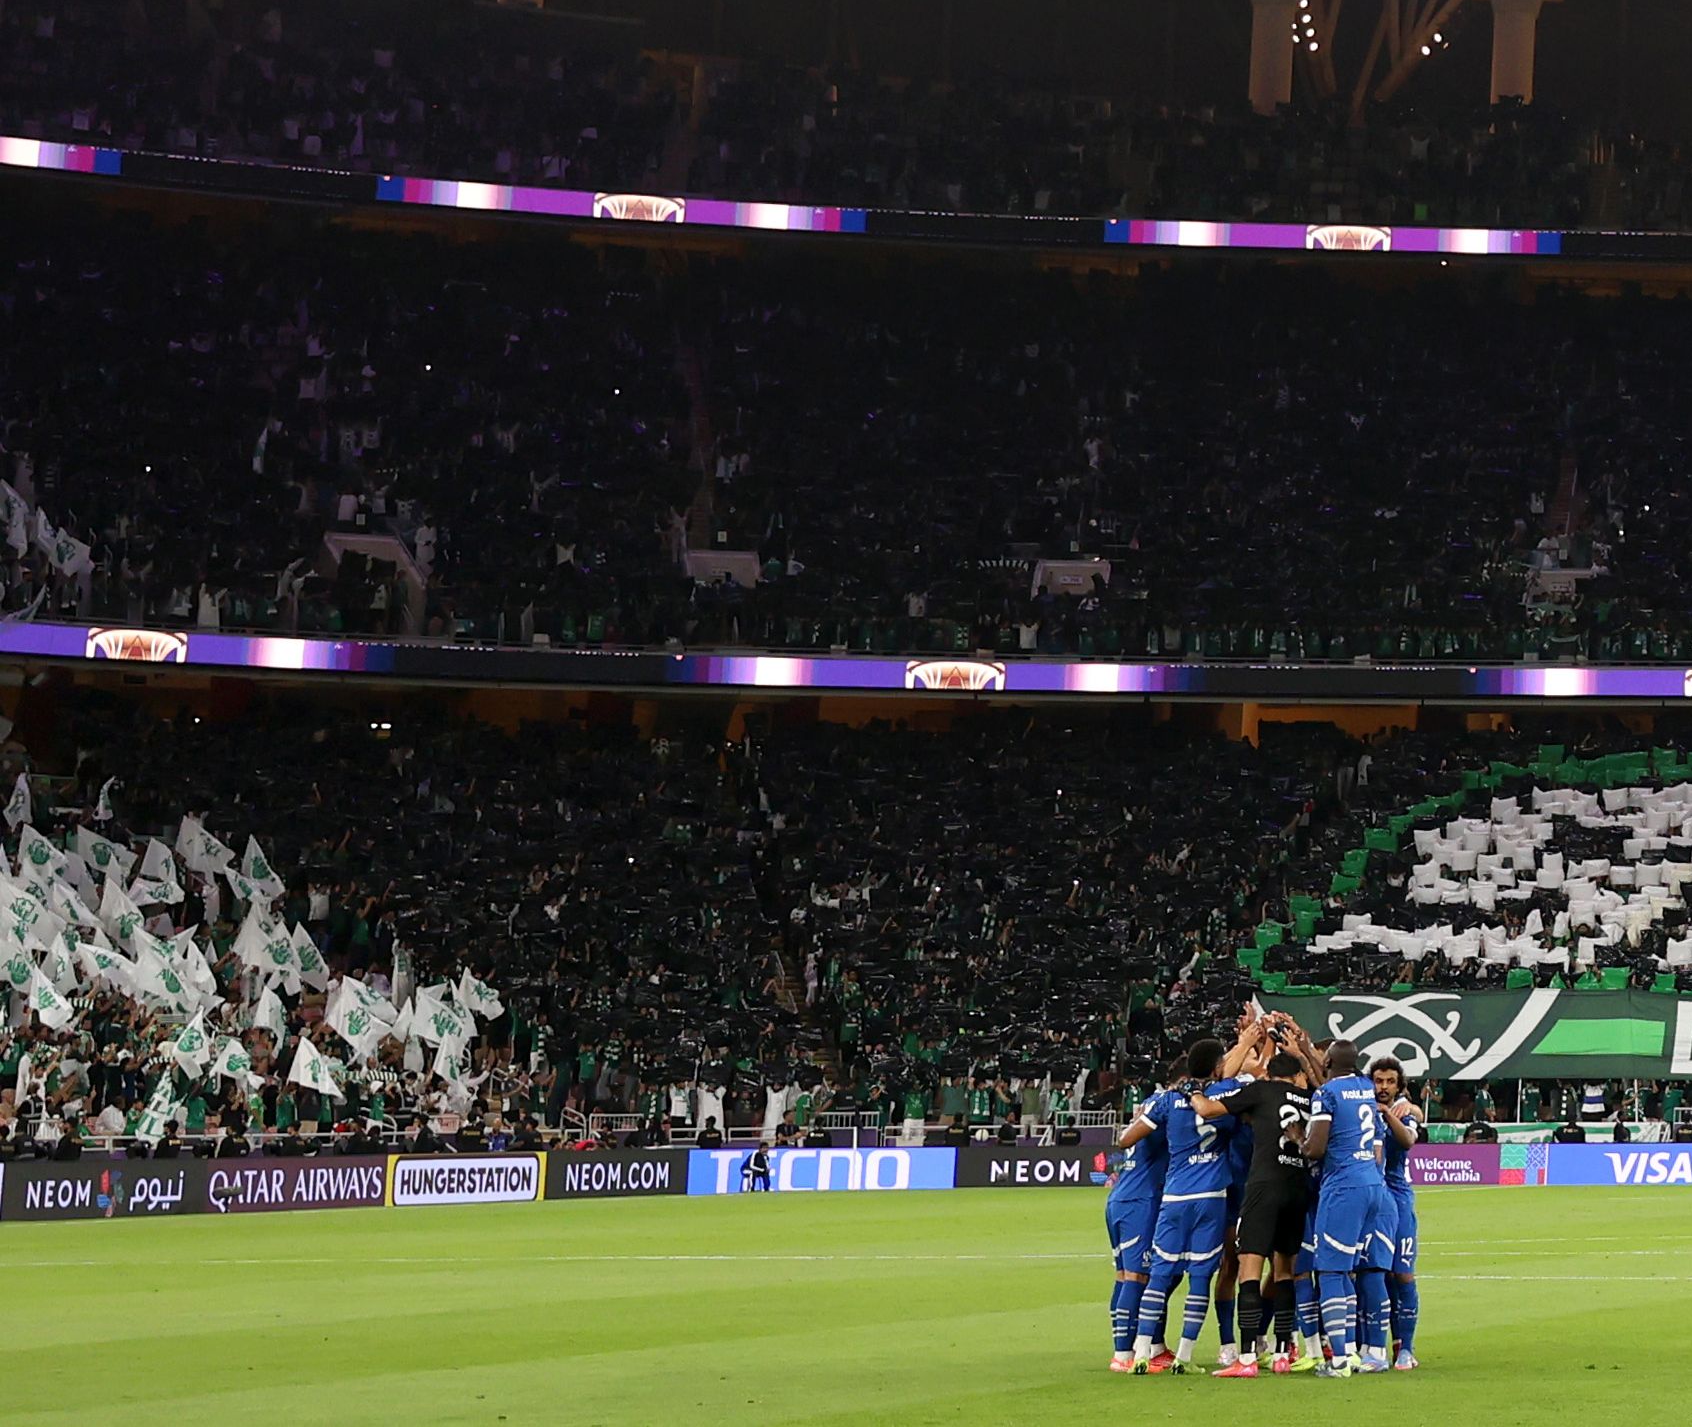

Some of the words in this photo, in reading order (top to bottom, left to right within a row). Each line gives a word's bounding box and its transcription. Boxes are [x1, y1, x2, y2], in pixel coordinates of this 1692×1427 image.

[565, 1161, 670, 1192] NEOM.COM
[990, 1159, 1080, 1183] NEOM
[1414, 1157, 1472, 1170] Welcome
[1424, 1171, 1437, 1182] to
[1440, 1170, 1480, 1182] Arabia
[26, 1180, 92, 1209] NEOM
[129, 1170, 185, 1212] نيوم
[209, 1169, 285, 1213] QATAR
[292, 1166, 383, 1202] AIRWAYS
[400, 1166, 533, 1195] HUNGERSTATION
[1401, 1237, 1414, 1255] 12
